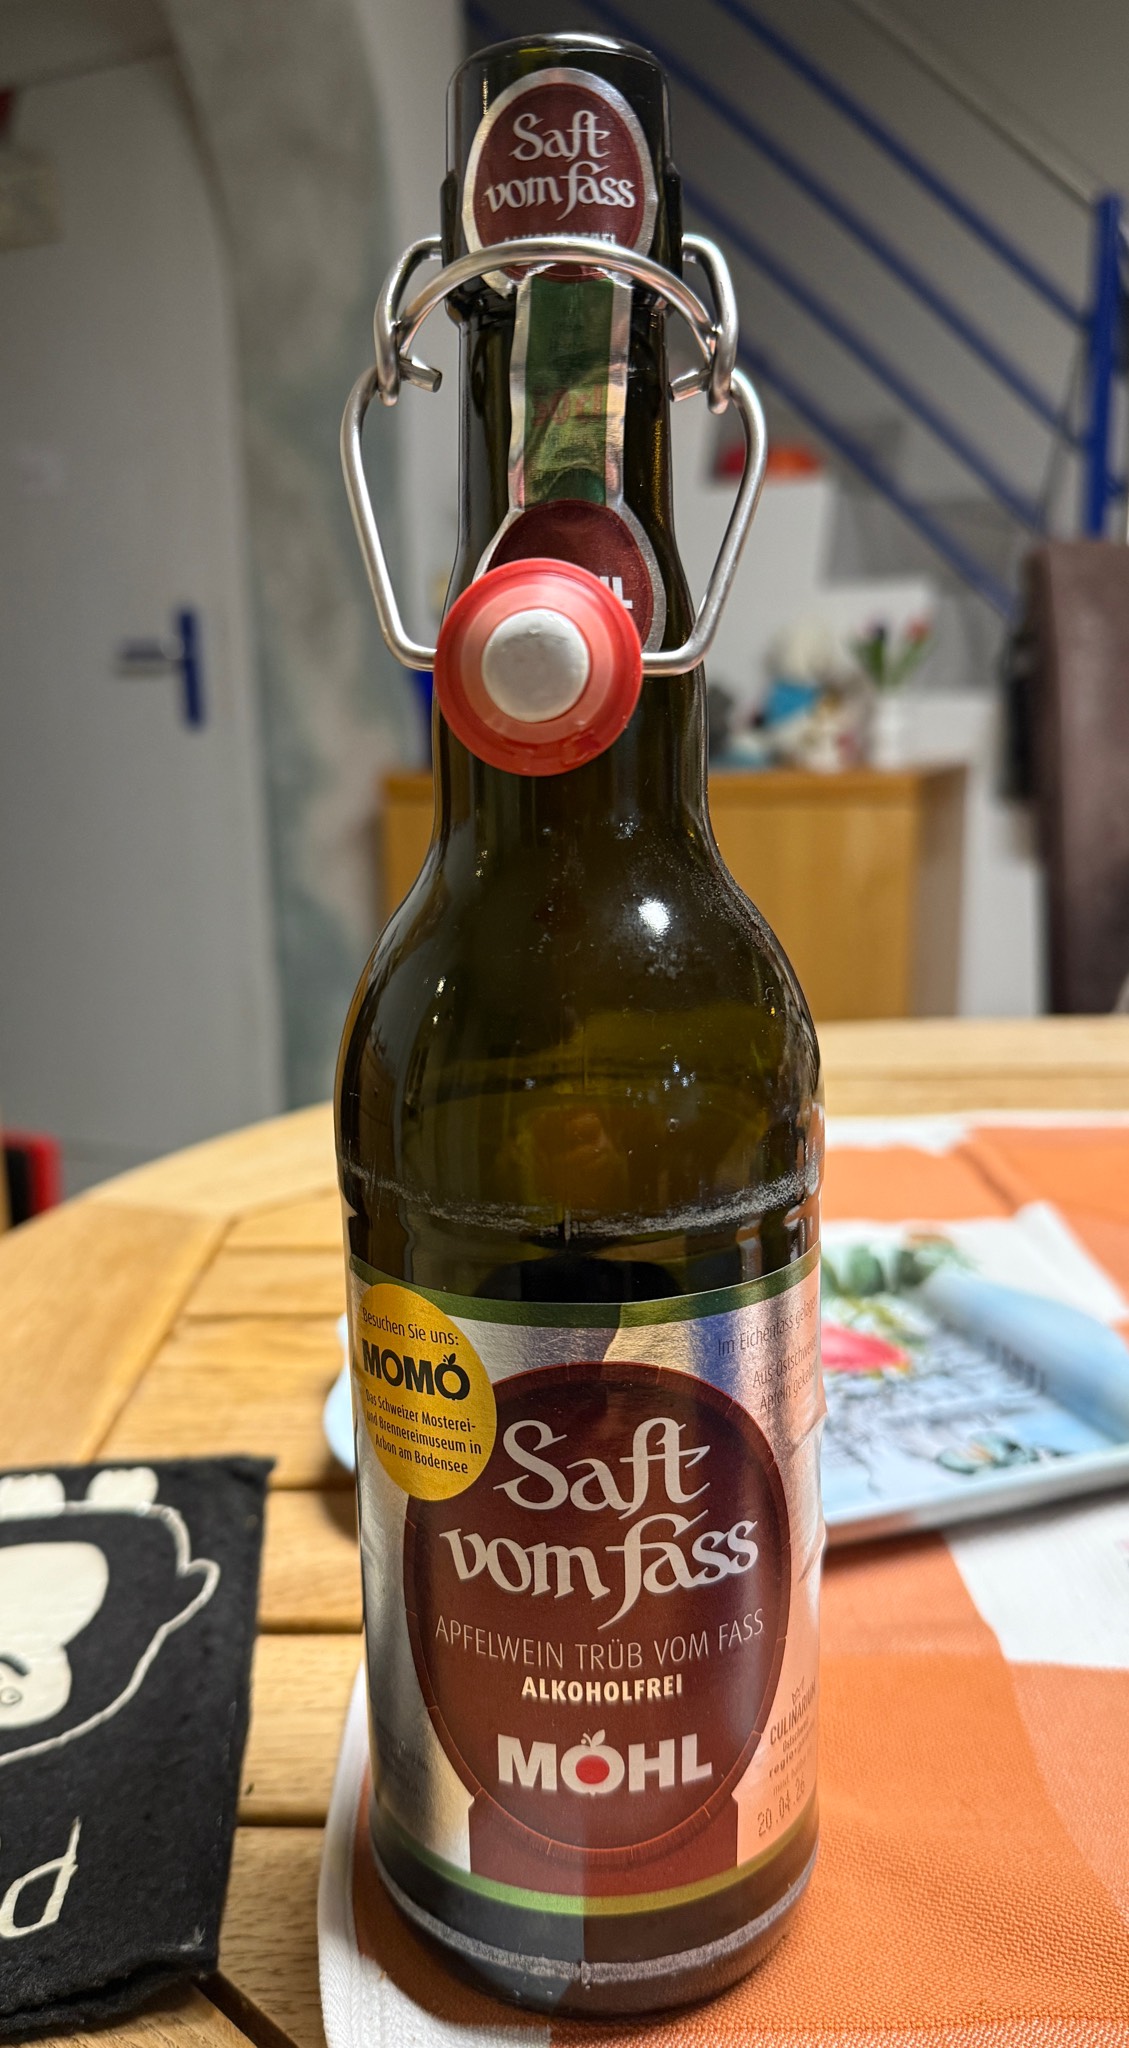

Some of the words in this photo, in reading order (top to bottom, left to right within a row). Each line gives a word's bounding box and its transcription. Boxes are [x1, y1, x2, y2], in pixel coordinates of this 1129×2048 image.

[509, 110, 611, 162] Saft
[483, 176, 563, 213] vom
[362, 1307, 405, 1337] Besuchen
[407, 1323, 426, 1342] Sie
[430, 1330, 459, 1346] uns:
[718, 1338, 735, 1357] Im
[740, 1315, 793, 1350] Eichenfass
[753, 1367, 772, 1388] Aus
[365, 1388, 377, 1406] Das
[378, 1395, 419, 1422] Schweizer
[421, 1411, 476, 1433] Mosterei-
[366, 1409, 378, 1426] und
[379, 1416, 467, 1453] Brennereimuseum
[469, 1439, 482, 1455] in
[375, 1434, 397, 1455] Arbon
[398, 1446, 413, 1462] am
[414, 1451, 468, 1474] Bodensee
[493, 1417, 710, 1519] Saft
[439, 1528, 610, 1601] vom
[435, 1614, 564, 1669] APFELWEIN
[575, 1637, 643, 1670] TRÜB
[653, 1631, 708, 1664] VOM
[718, 1608, 764, 1651] FASS
[521, 1673, 682, 1703] ALKOHOLFREI
